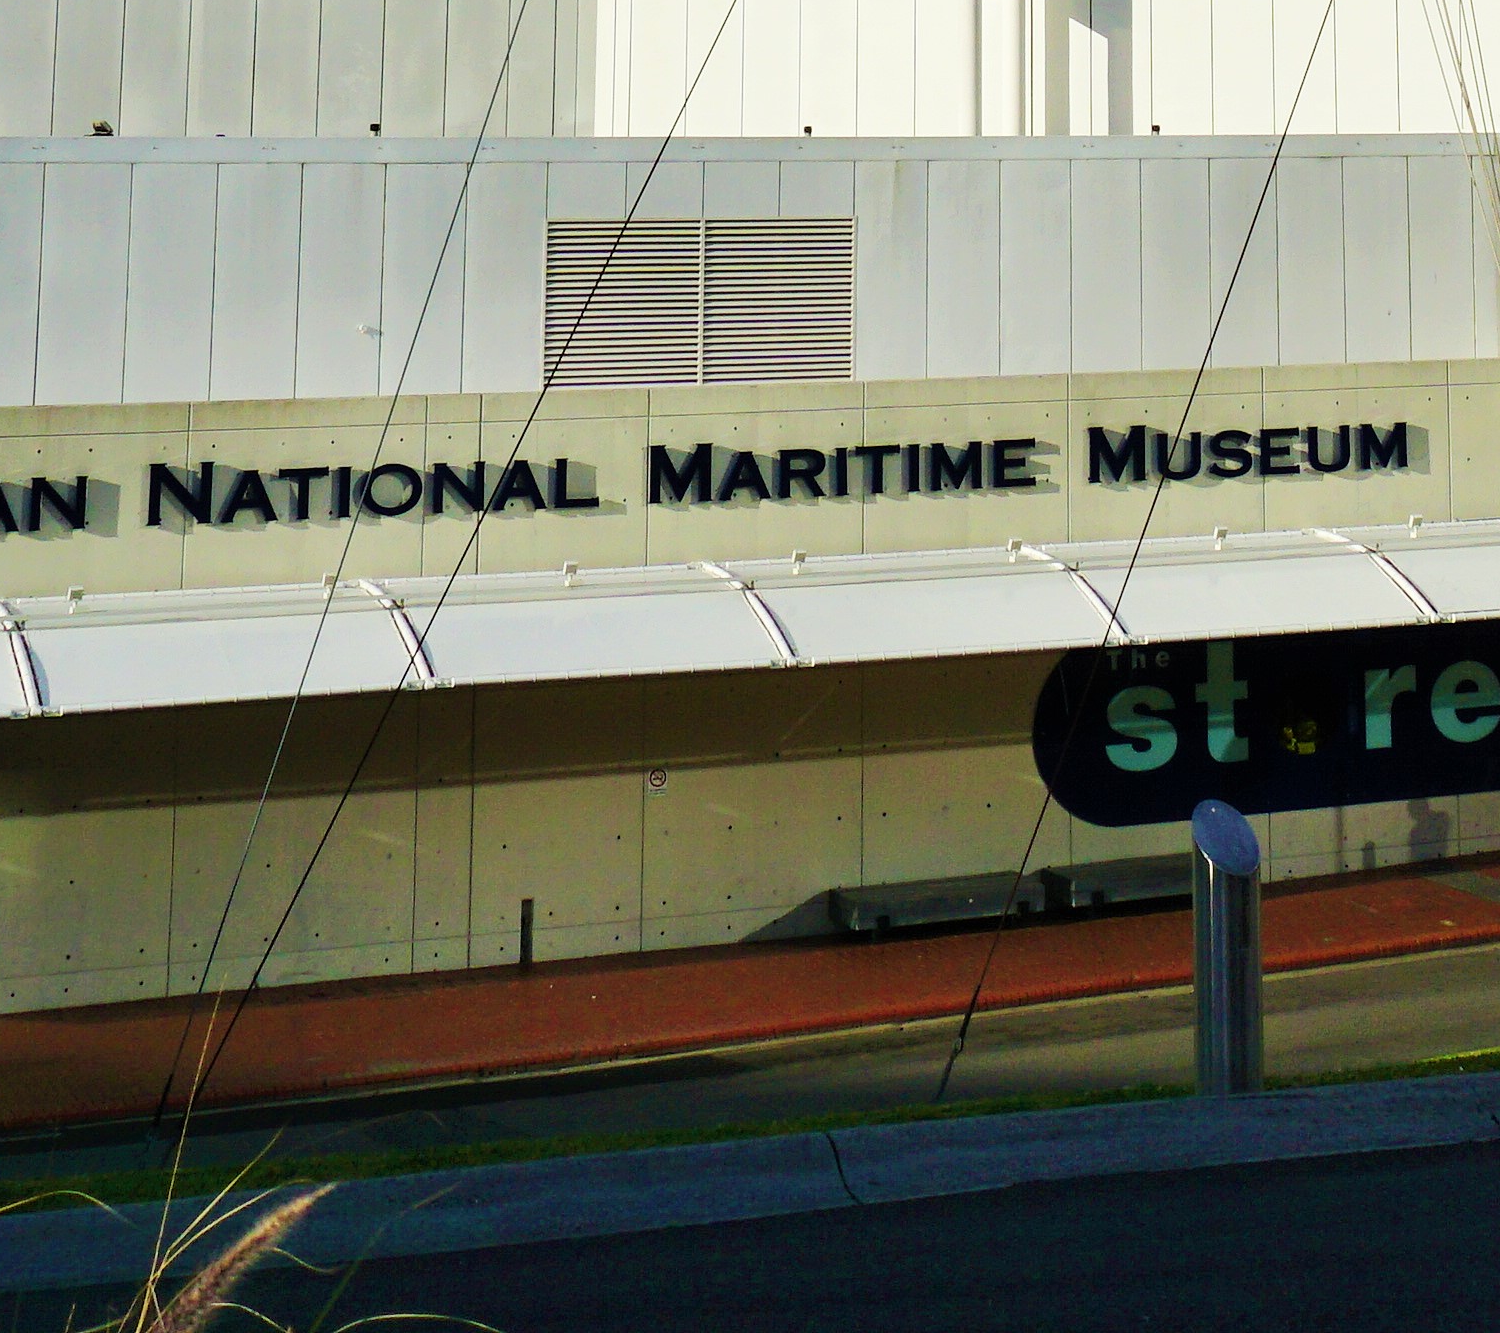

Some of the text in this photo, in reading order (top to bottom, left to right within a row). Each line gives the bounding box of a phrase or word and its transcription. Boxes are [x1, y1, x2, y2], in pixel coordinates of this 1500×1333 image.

[147, 458, 599, 527] NATIONAL
[648, 437, 1038, 505] MARITIME
[1087, 422, 1408, 484] MUSEUM
[1106, 648, 1171, 671] The
